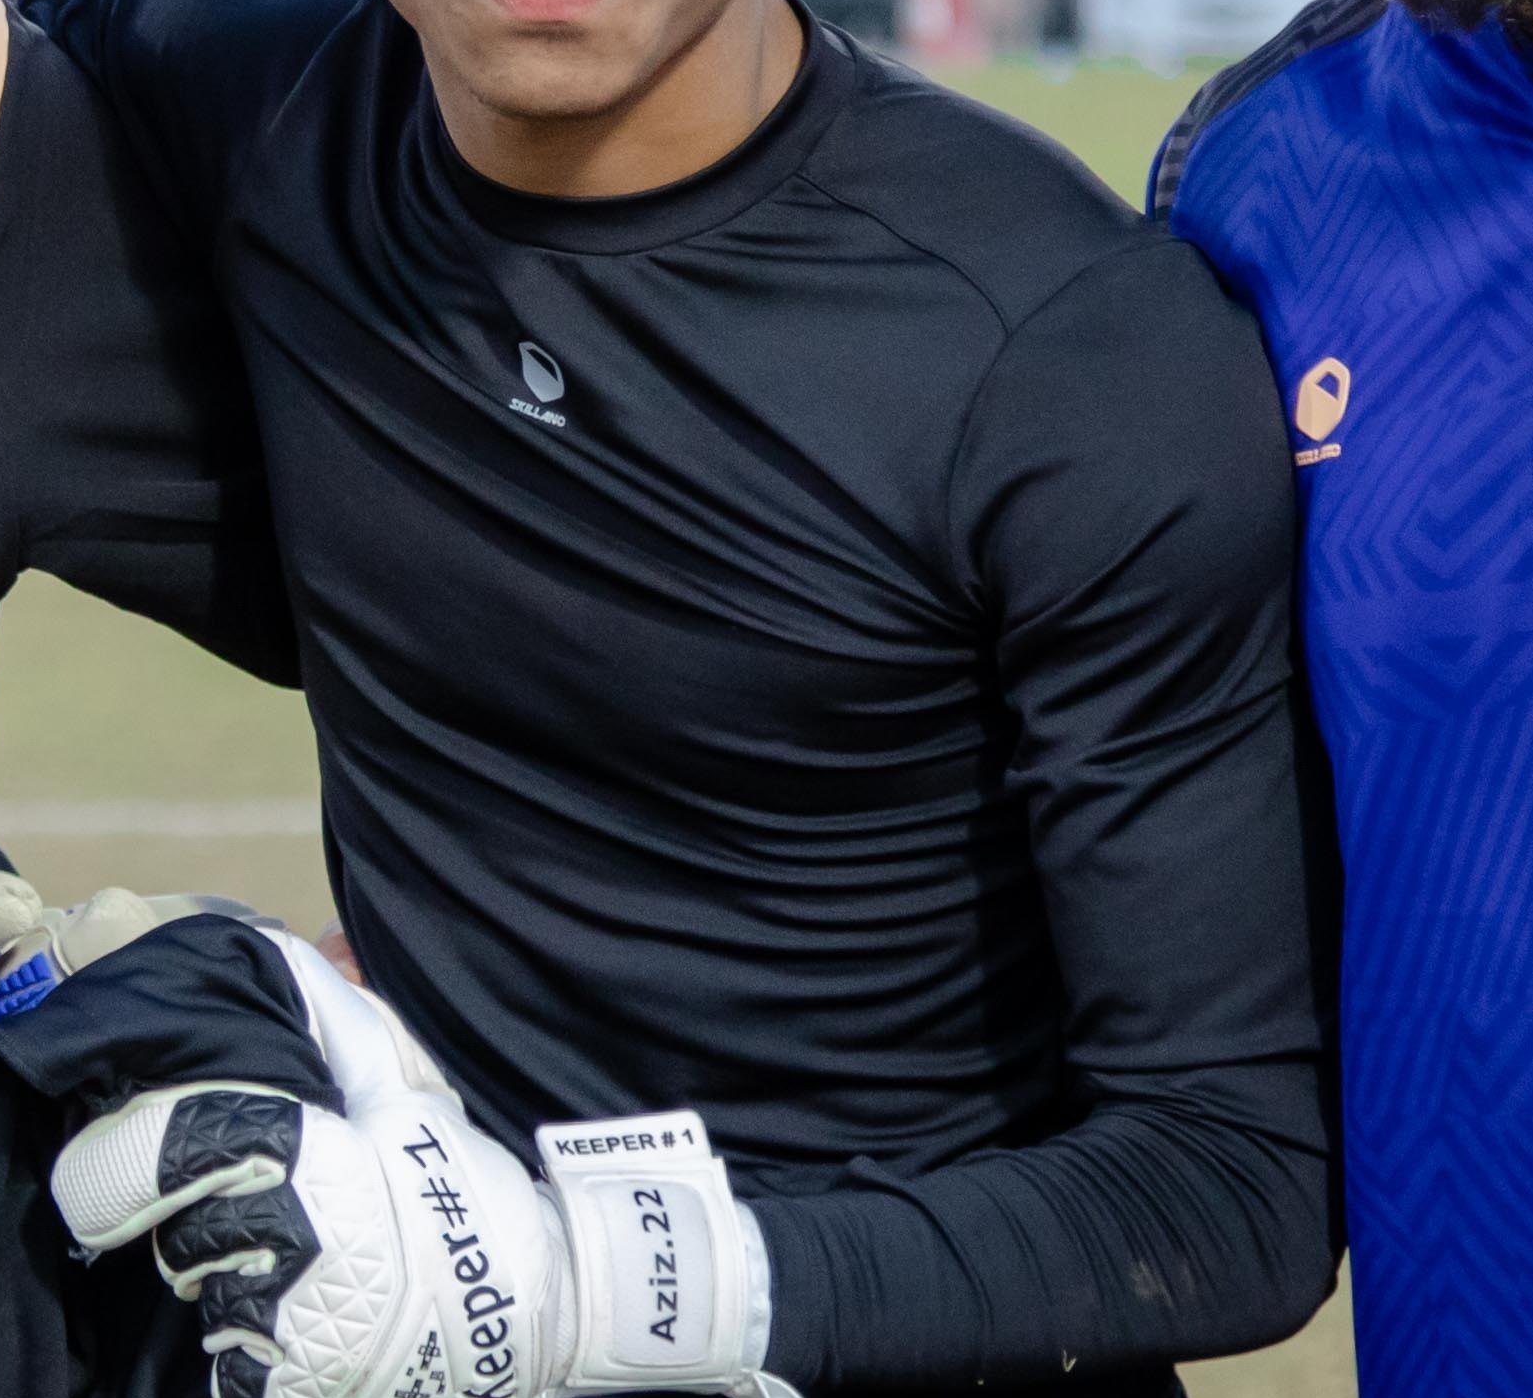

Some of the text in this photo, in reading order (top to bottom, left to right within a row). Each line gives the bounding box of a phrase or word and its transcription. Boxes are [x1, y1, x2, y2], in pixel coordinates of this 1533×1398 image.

[554, 1128, 696, 1156] KEEPER # 1
[633, 1187, 679, 1345] Aziz.22
